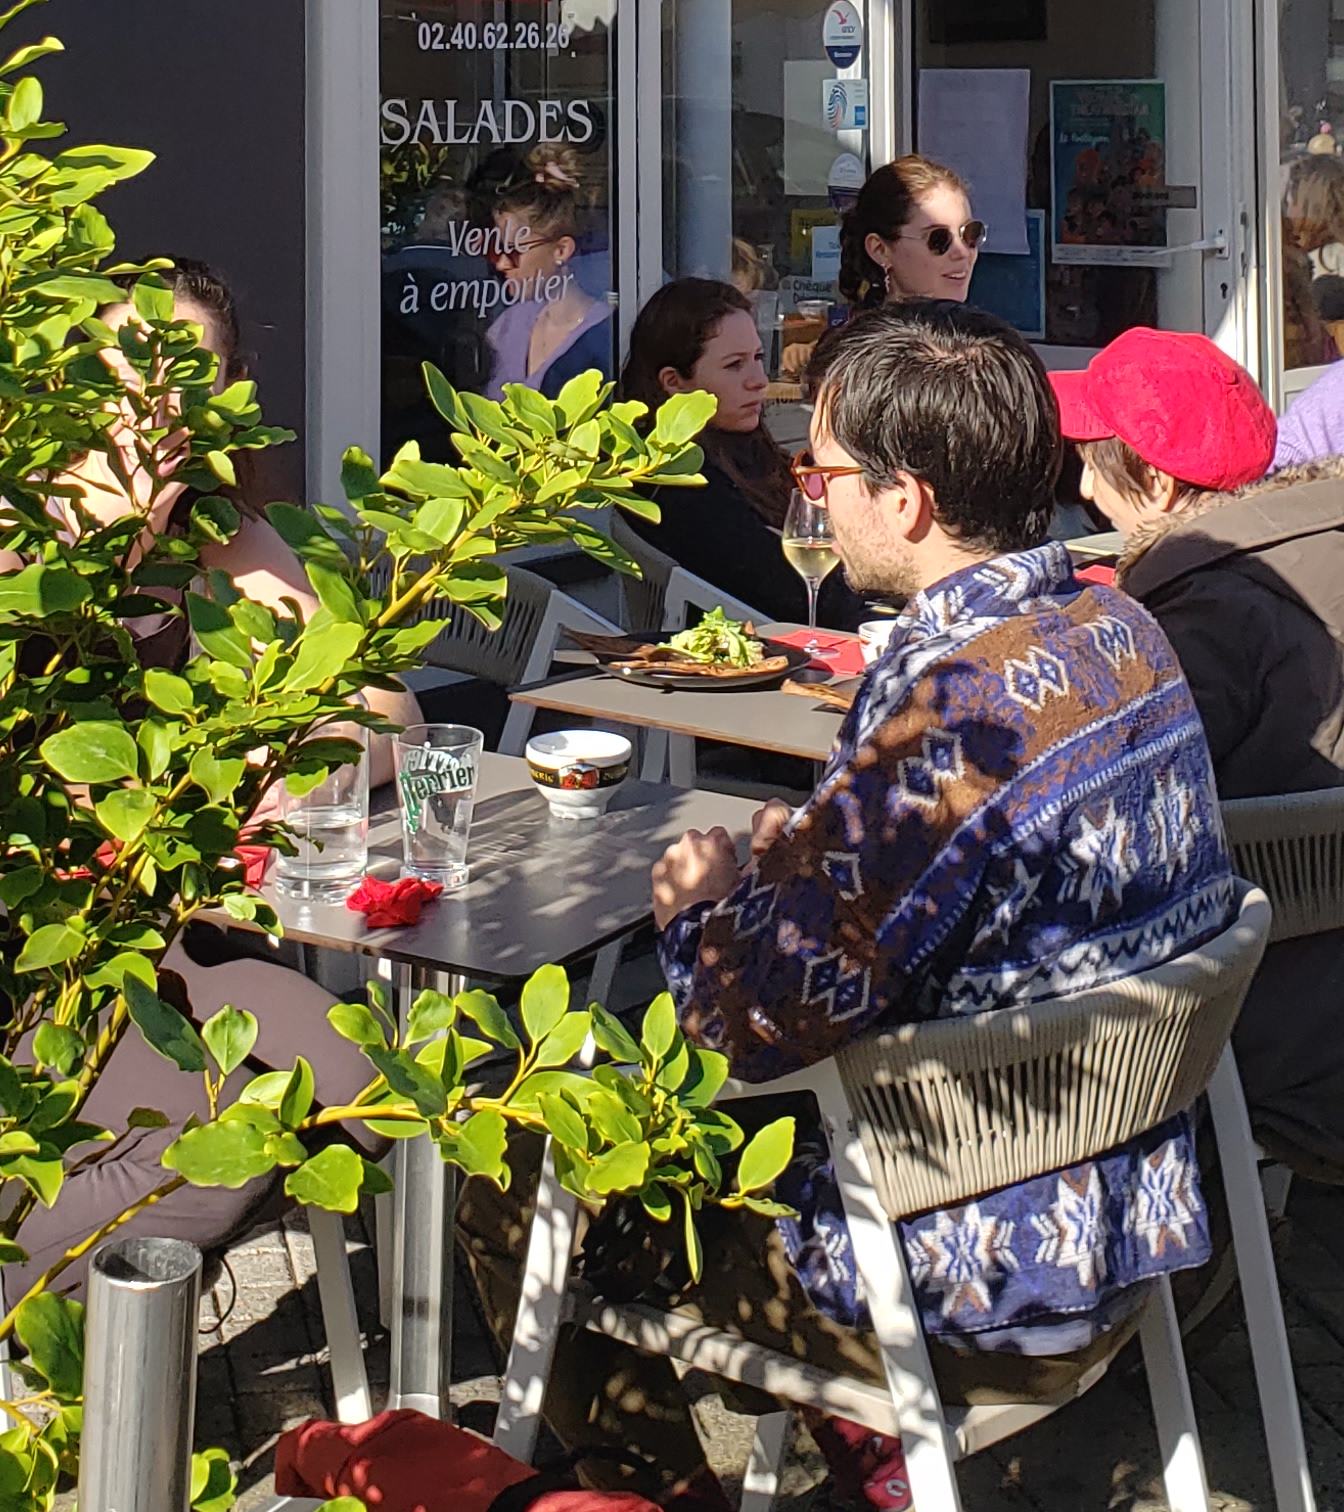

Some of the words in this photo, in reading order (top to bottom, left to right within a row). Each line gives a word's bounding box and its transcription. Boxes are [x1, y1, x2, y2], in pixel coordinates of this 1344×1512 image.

[381, 98, 593, 145] SALADES
[399, 273, 420, 314] à
[430, 270, 575, 319] emporter
[399, 763, 475, 835] Perrier
